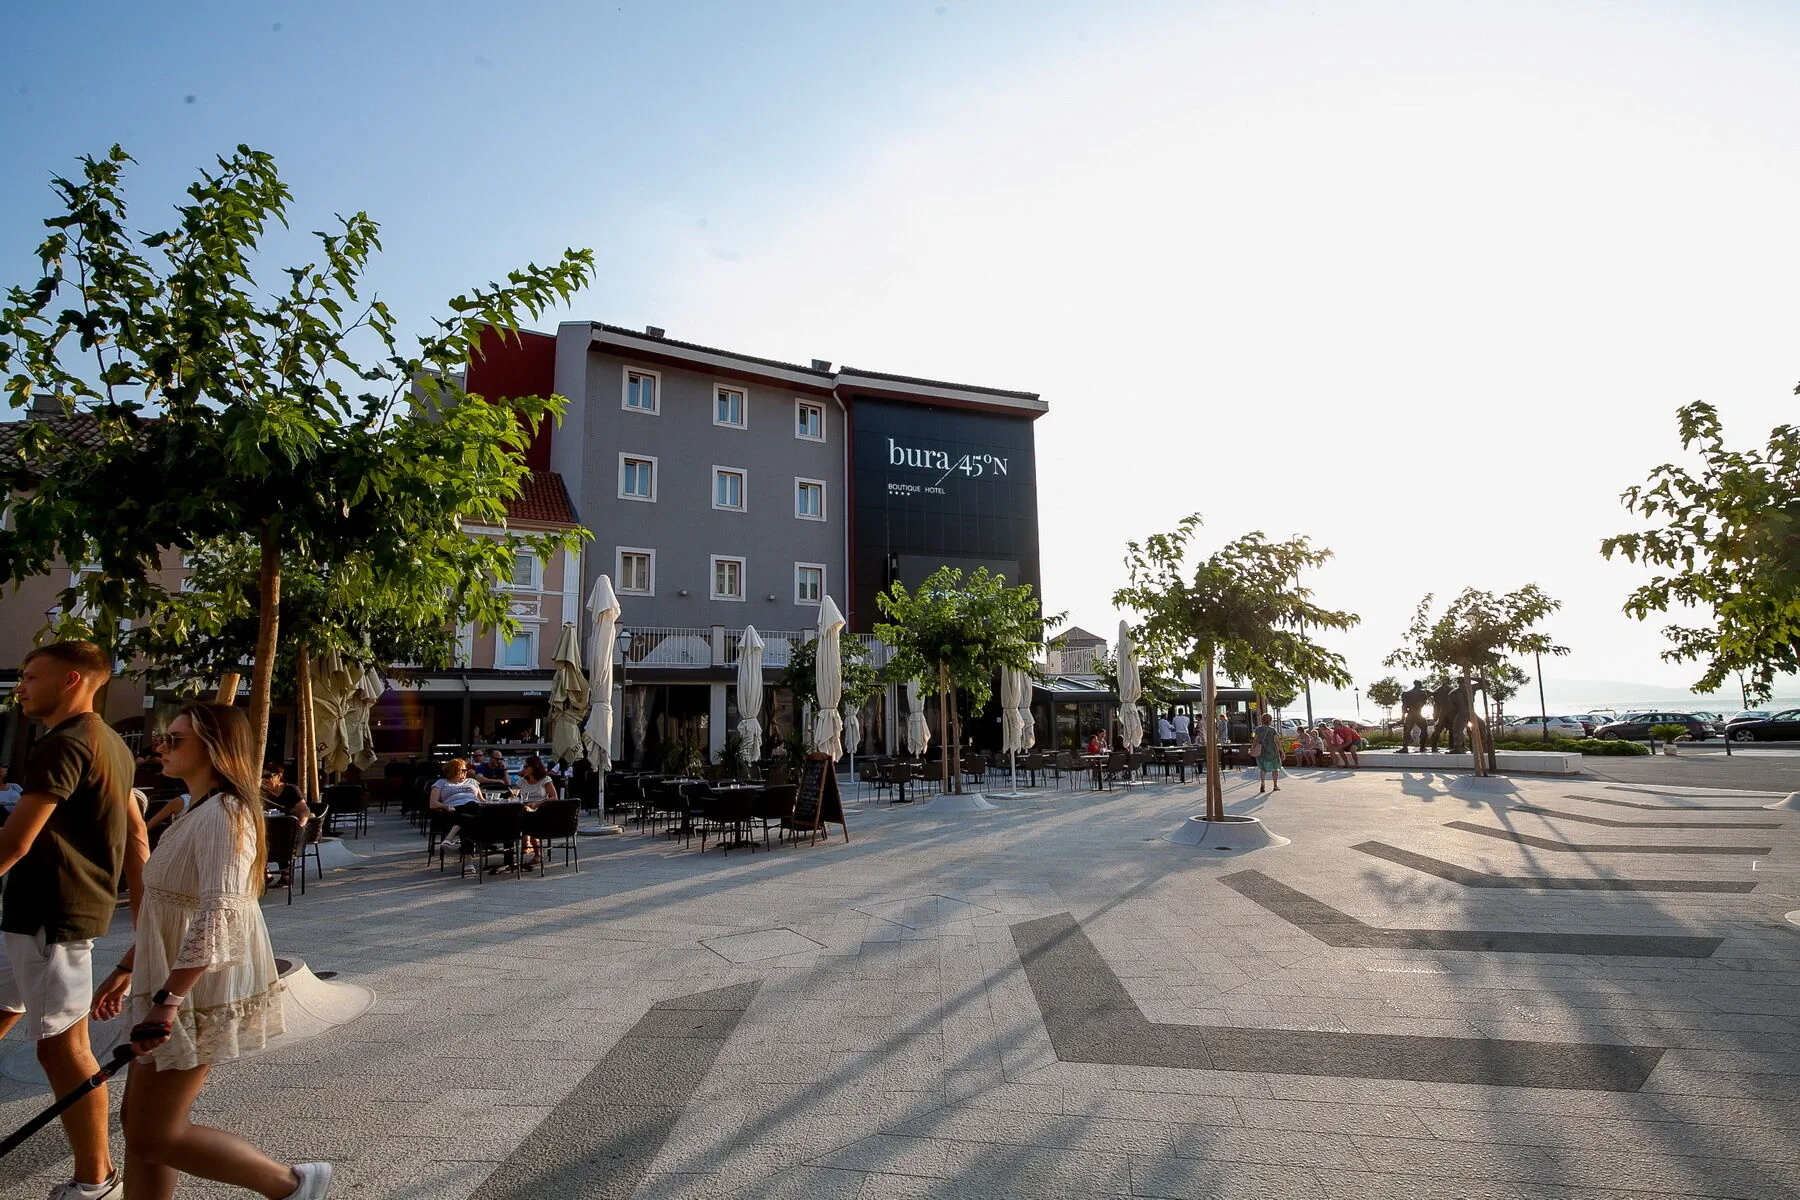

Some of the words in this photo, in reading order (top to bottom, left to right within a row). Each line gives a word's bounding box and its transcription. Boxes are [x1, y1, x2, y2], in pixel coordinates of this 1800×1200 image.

[887, 438, 951, 470] bura
[888, 483, 921, 493] BOUTIQUE
[925, 486, 946, 495] HOTEL
